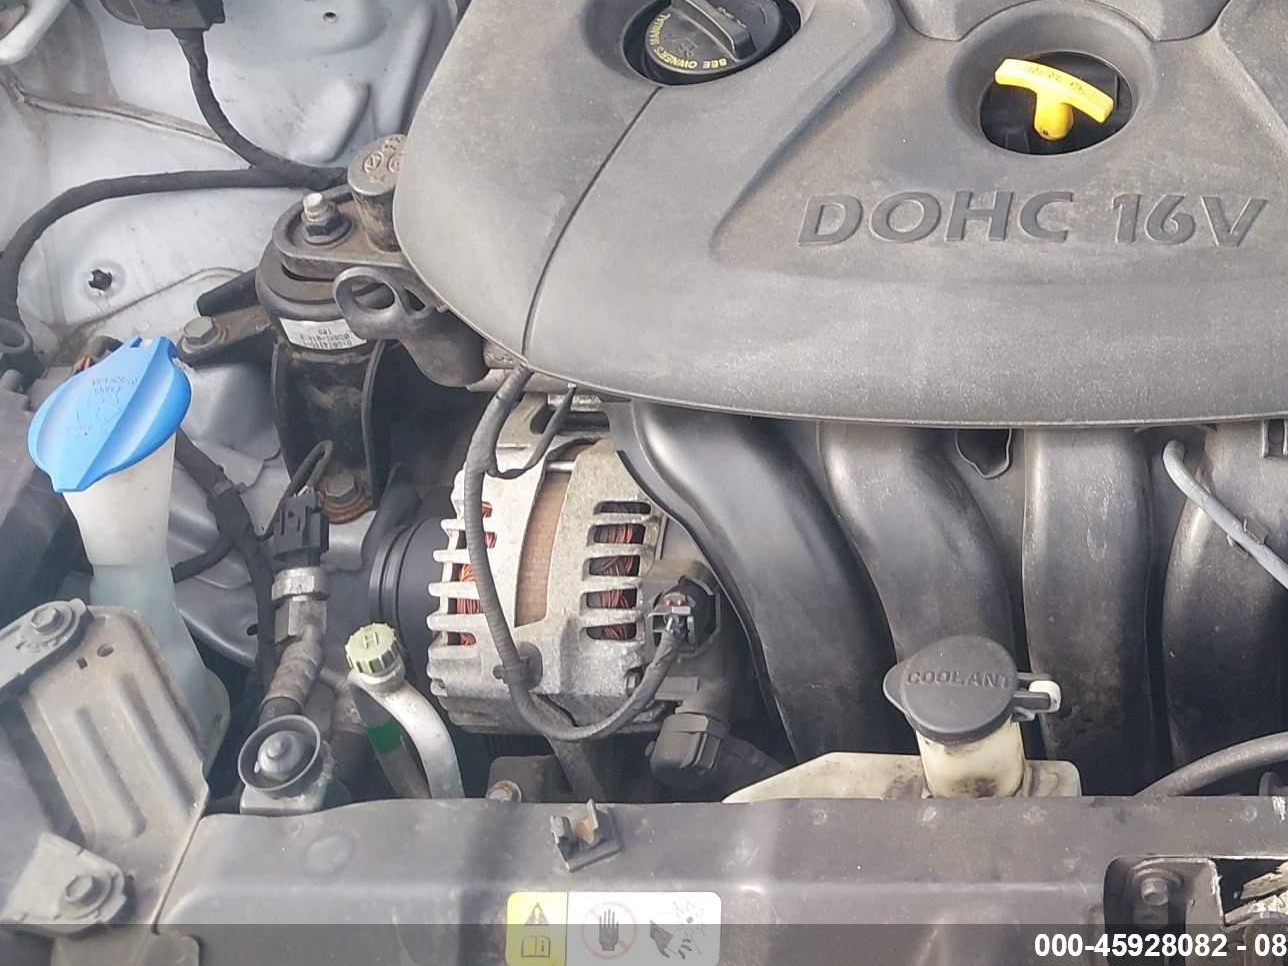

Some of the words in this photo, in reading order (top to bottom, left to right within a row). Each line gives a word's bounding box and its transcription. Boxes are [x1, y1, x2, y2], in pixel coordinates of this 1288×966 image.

[649, 13, 672, 46] MANUAL
[702, 58, 727, 69] SEE
[797, 190, 1074, 247] DOHC
[1111, 192, 1270, 248] 16V
[906, 670, 1009, 691] COOLANT
